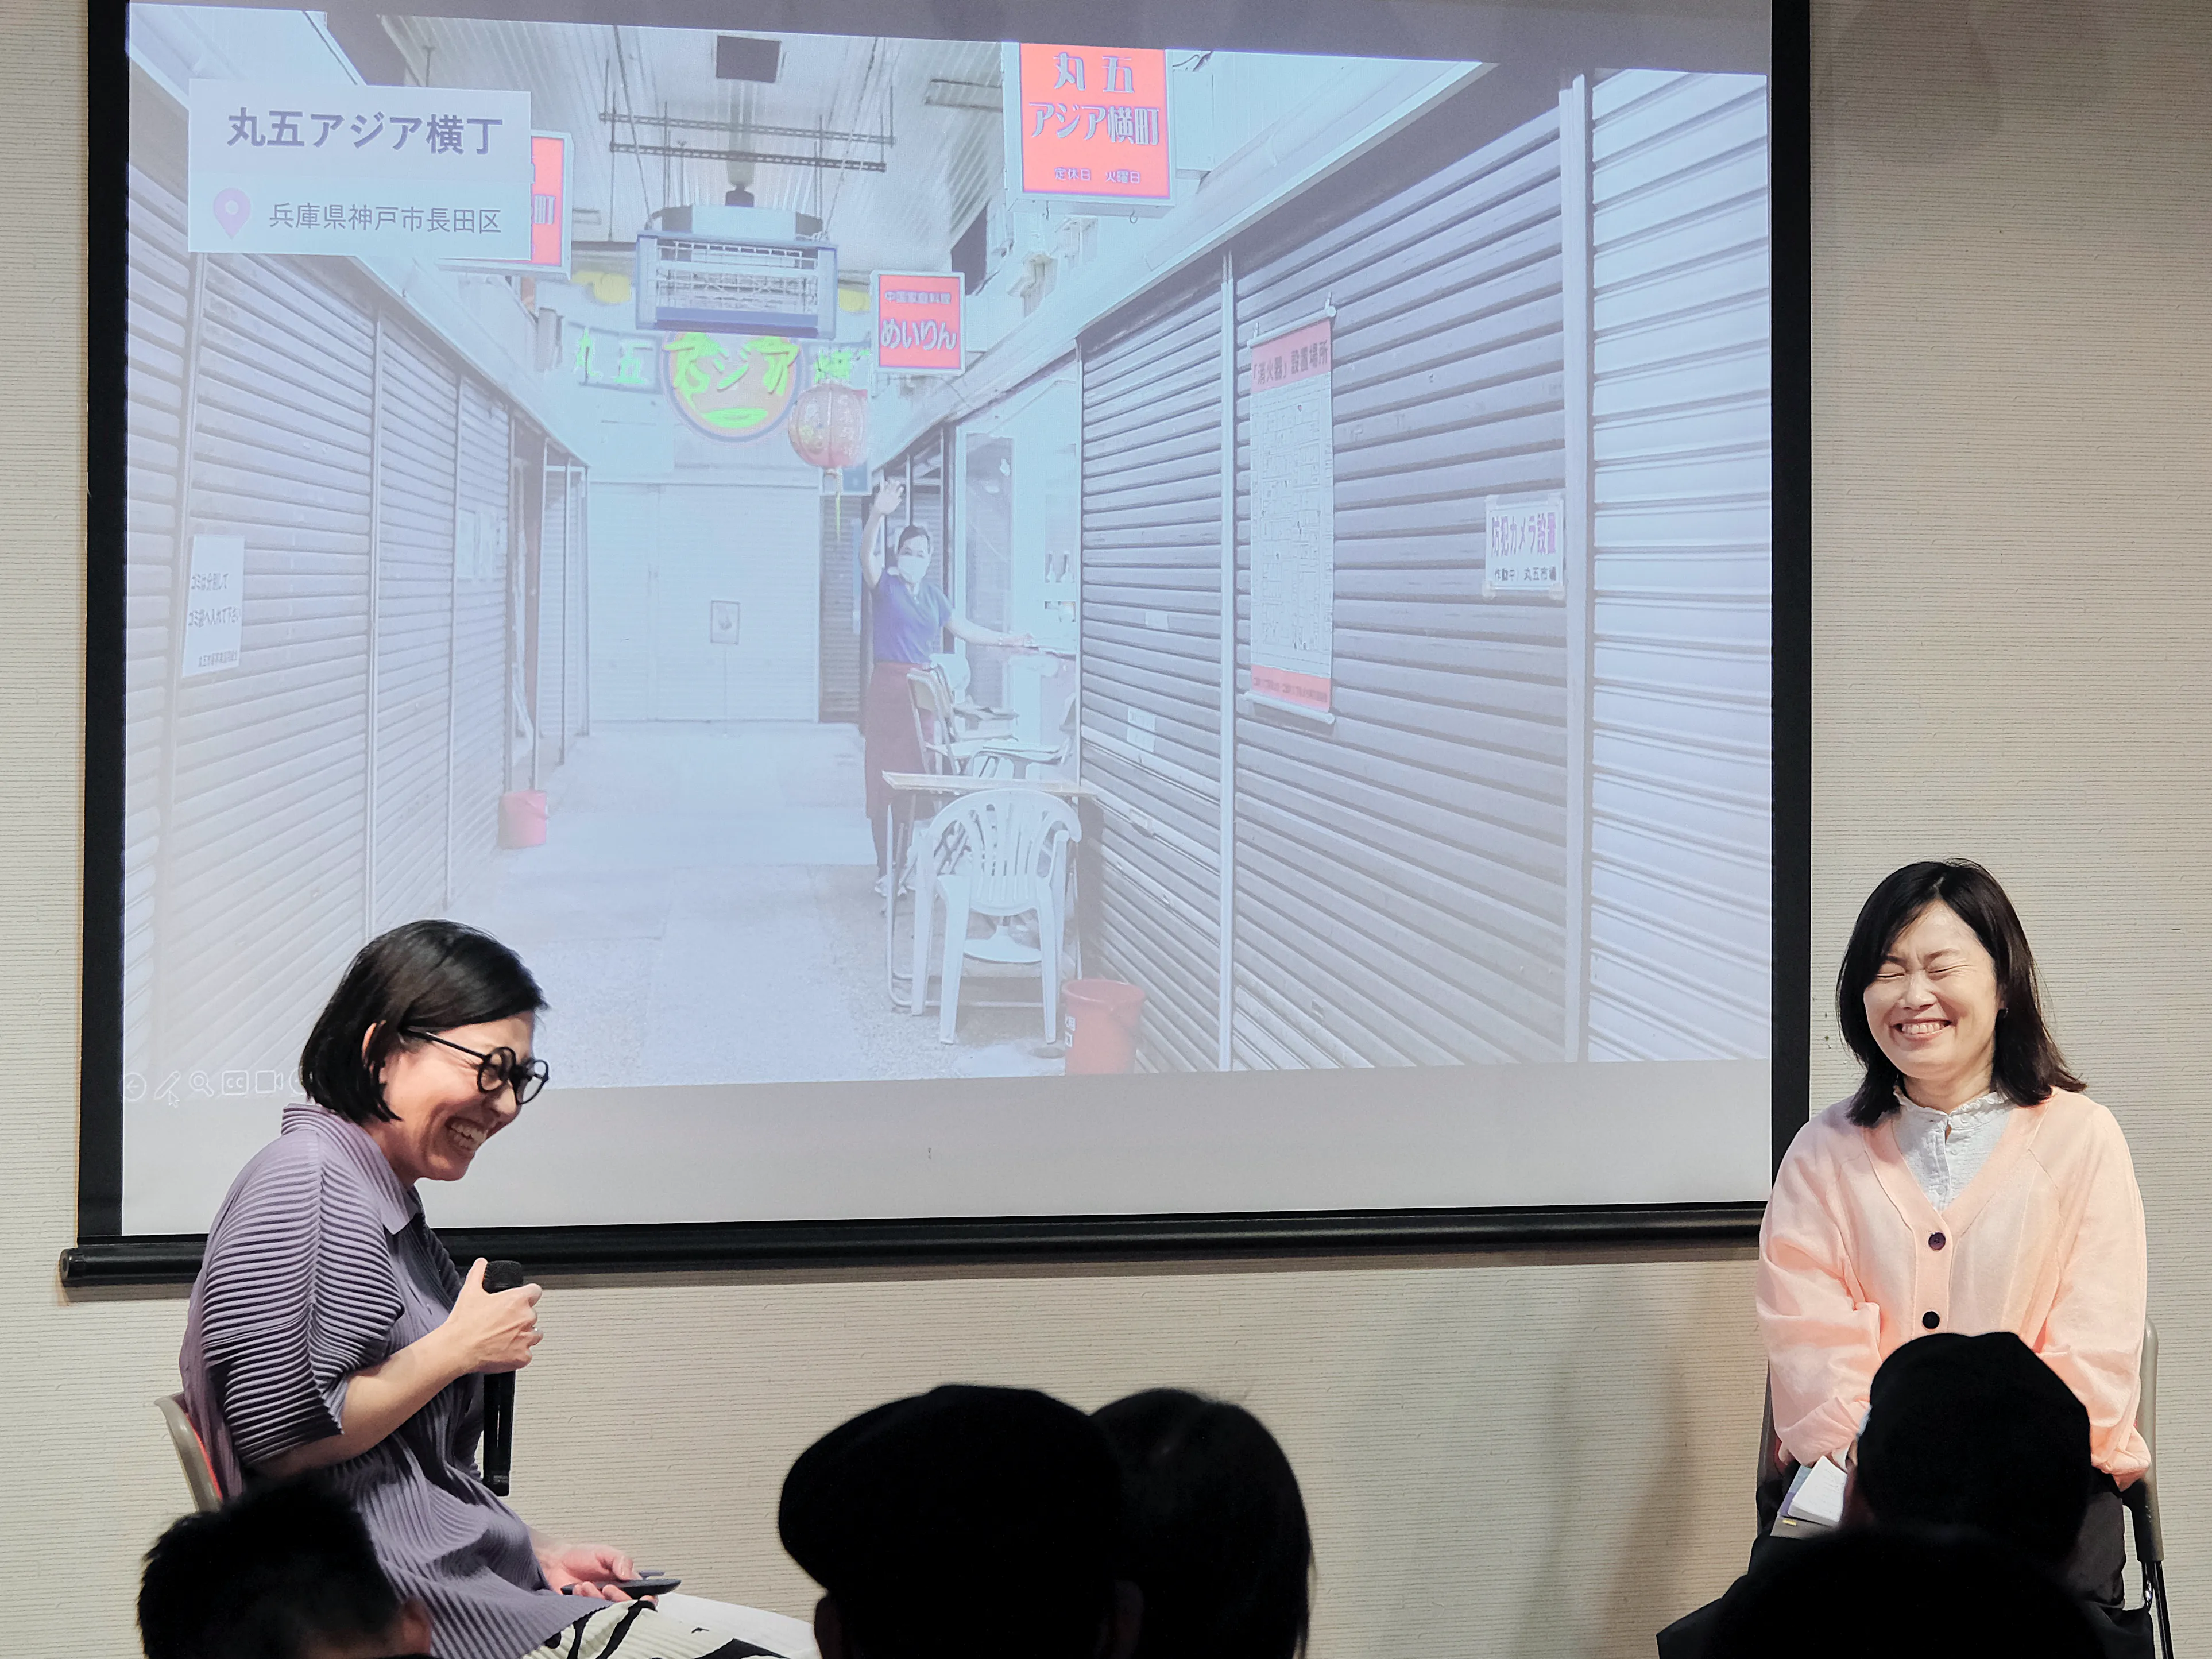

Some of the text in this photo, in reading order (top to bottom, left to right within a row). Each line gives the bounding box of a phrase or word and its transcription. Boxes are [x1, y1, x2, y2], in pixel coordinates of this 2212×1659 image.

[227, 107, 504, 155] 丸五アジア横丁
[1028, 102, 1160, 146] アジア横町
[1054, 167, 1141, 184] 定休日 火曜日
[269, 202, 502, 234] 兵庫県神戸市長田区
[881, 318, 957, 351] めいりん
[1491, 512, 1556, 557] 防犯カメラ設置
